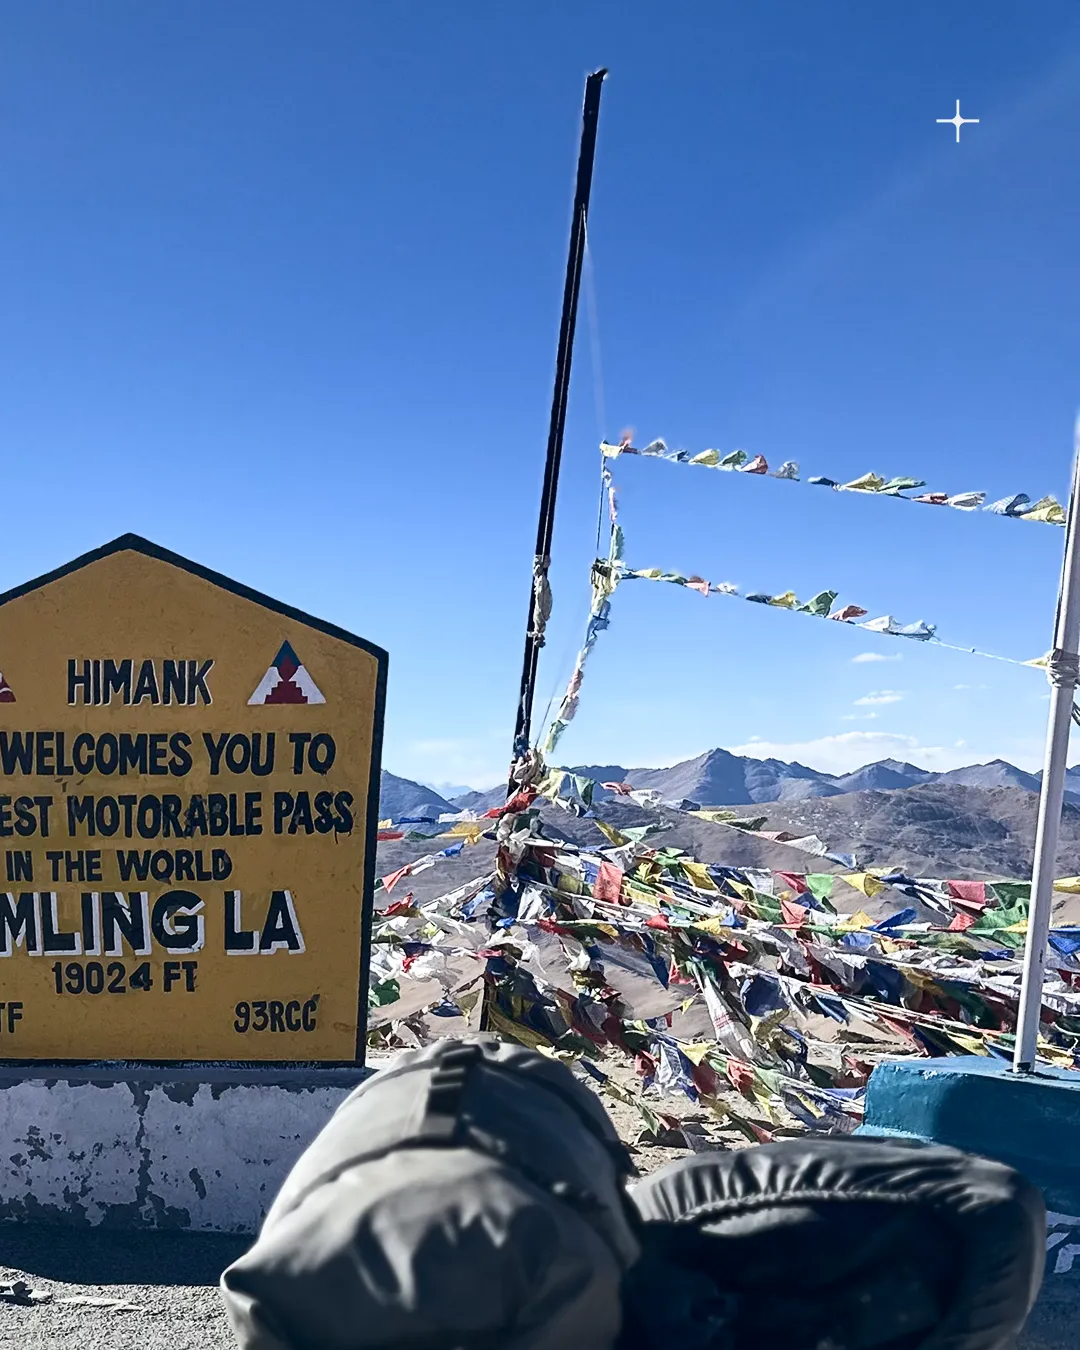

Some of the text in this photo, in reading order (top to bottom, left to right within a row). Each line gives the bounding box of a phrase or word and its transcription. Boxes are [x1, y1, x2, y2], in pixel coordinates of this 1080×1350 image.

[67, 658, 216, 706] HIMANK
[0, 731, 192, 777] WELCOMES
[203, 732, 274, 776] YOU
[288, 733, 336, 775] TO
[68, 791, 263, 840] MOTORABLE
[273, 790, 355, 836] PASS
[6, 849, 232, 882] IN THE WORLD
[224, 890, 306, 956] LA
[51, 961, 198, 995] 19024 FT
[233, 1000, 318, 1034] 93RCC
